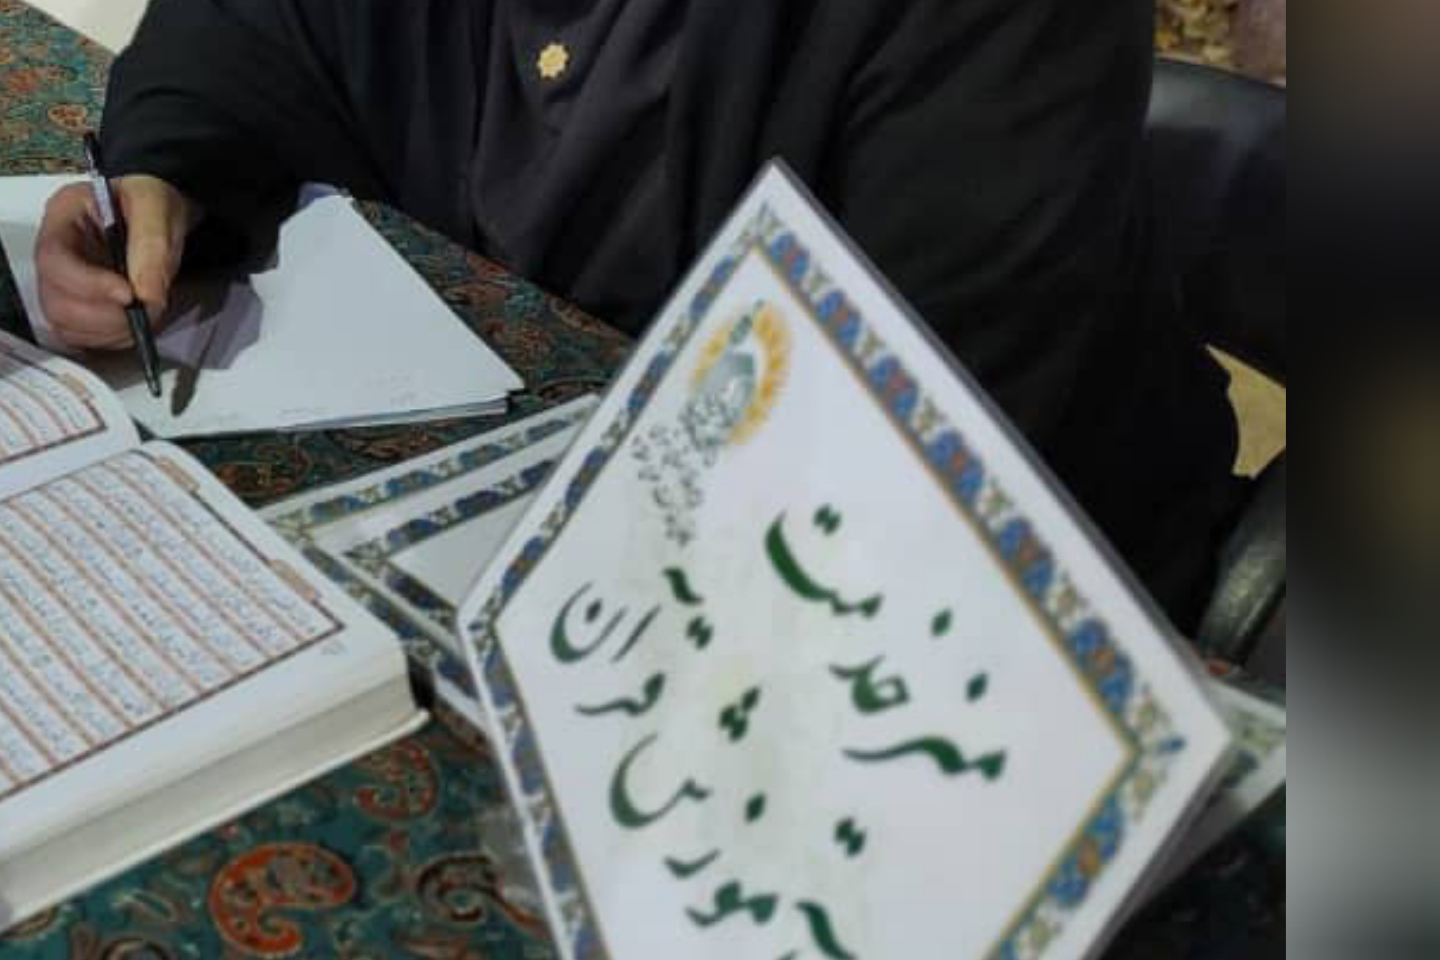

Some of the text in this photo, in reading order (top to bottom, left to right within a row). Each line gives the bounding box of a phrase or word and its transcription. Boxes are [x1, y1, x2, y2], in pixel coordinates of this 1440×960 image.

[548, 566, 715, 718] قرآن
[763, 503, 953, 717] خدمت
[607, 686, 858, 960] موزش
